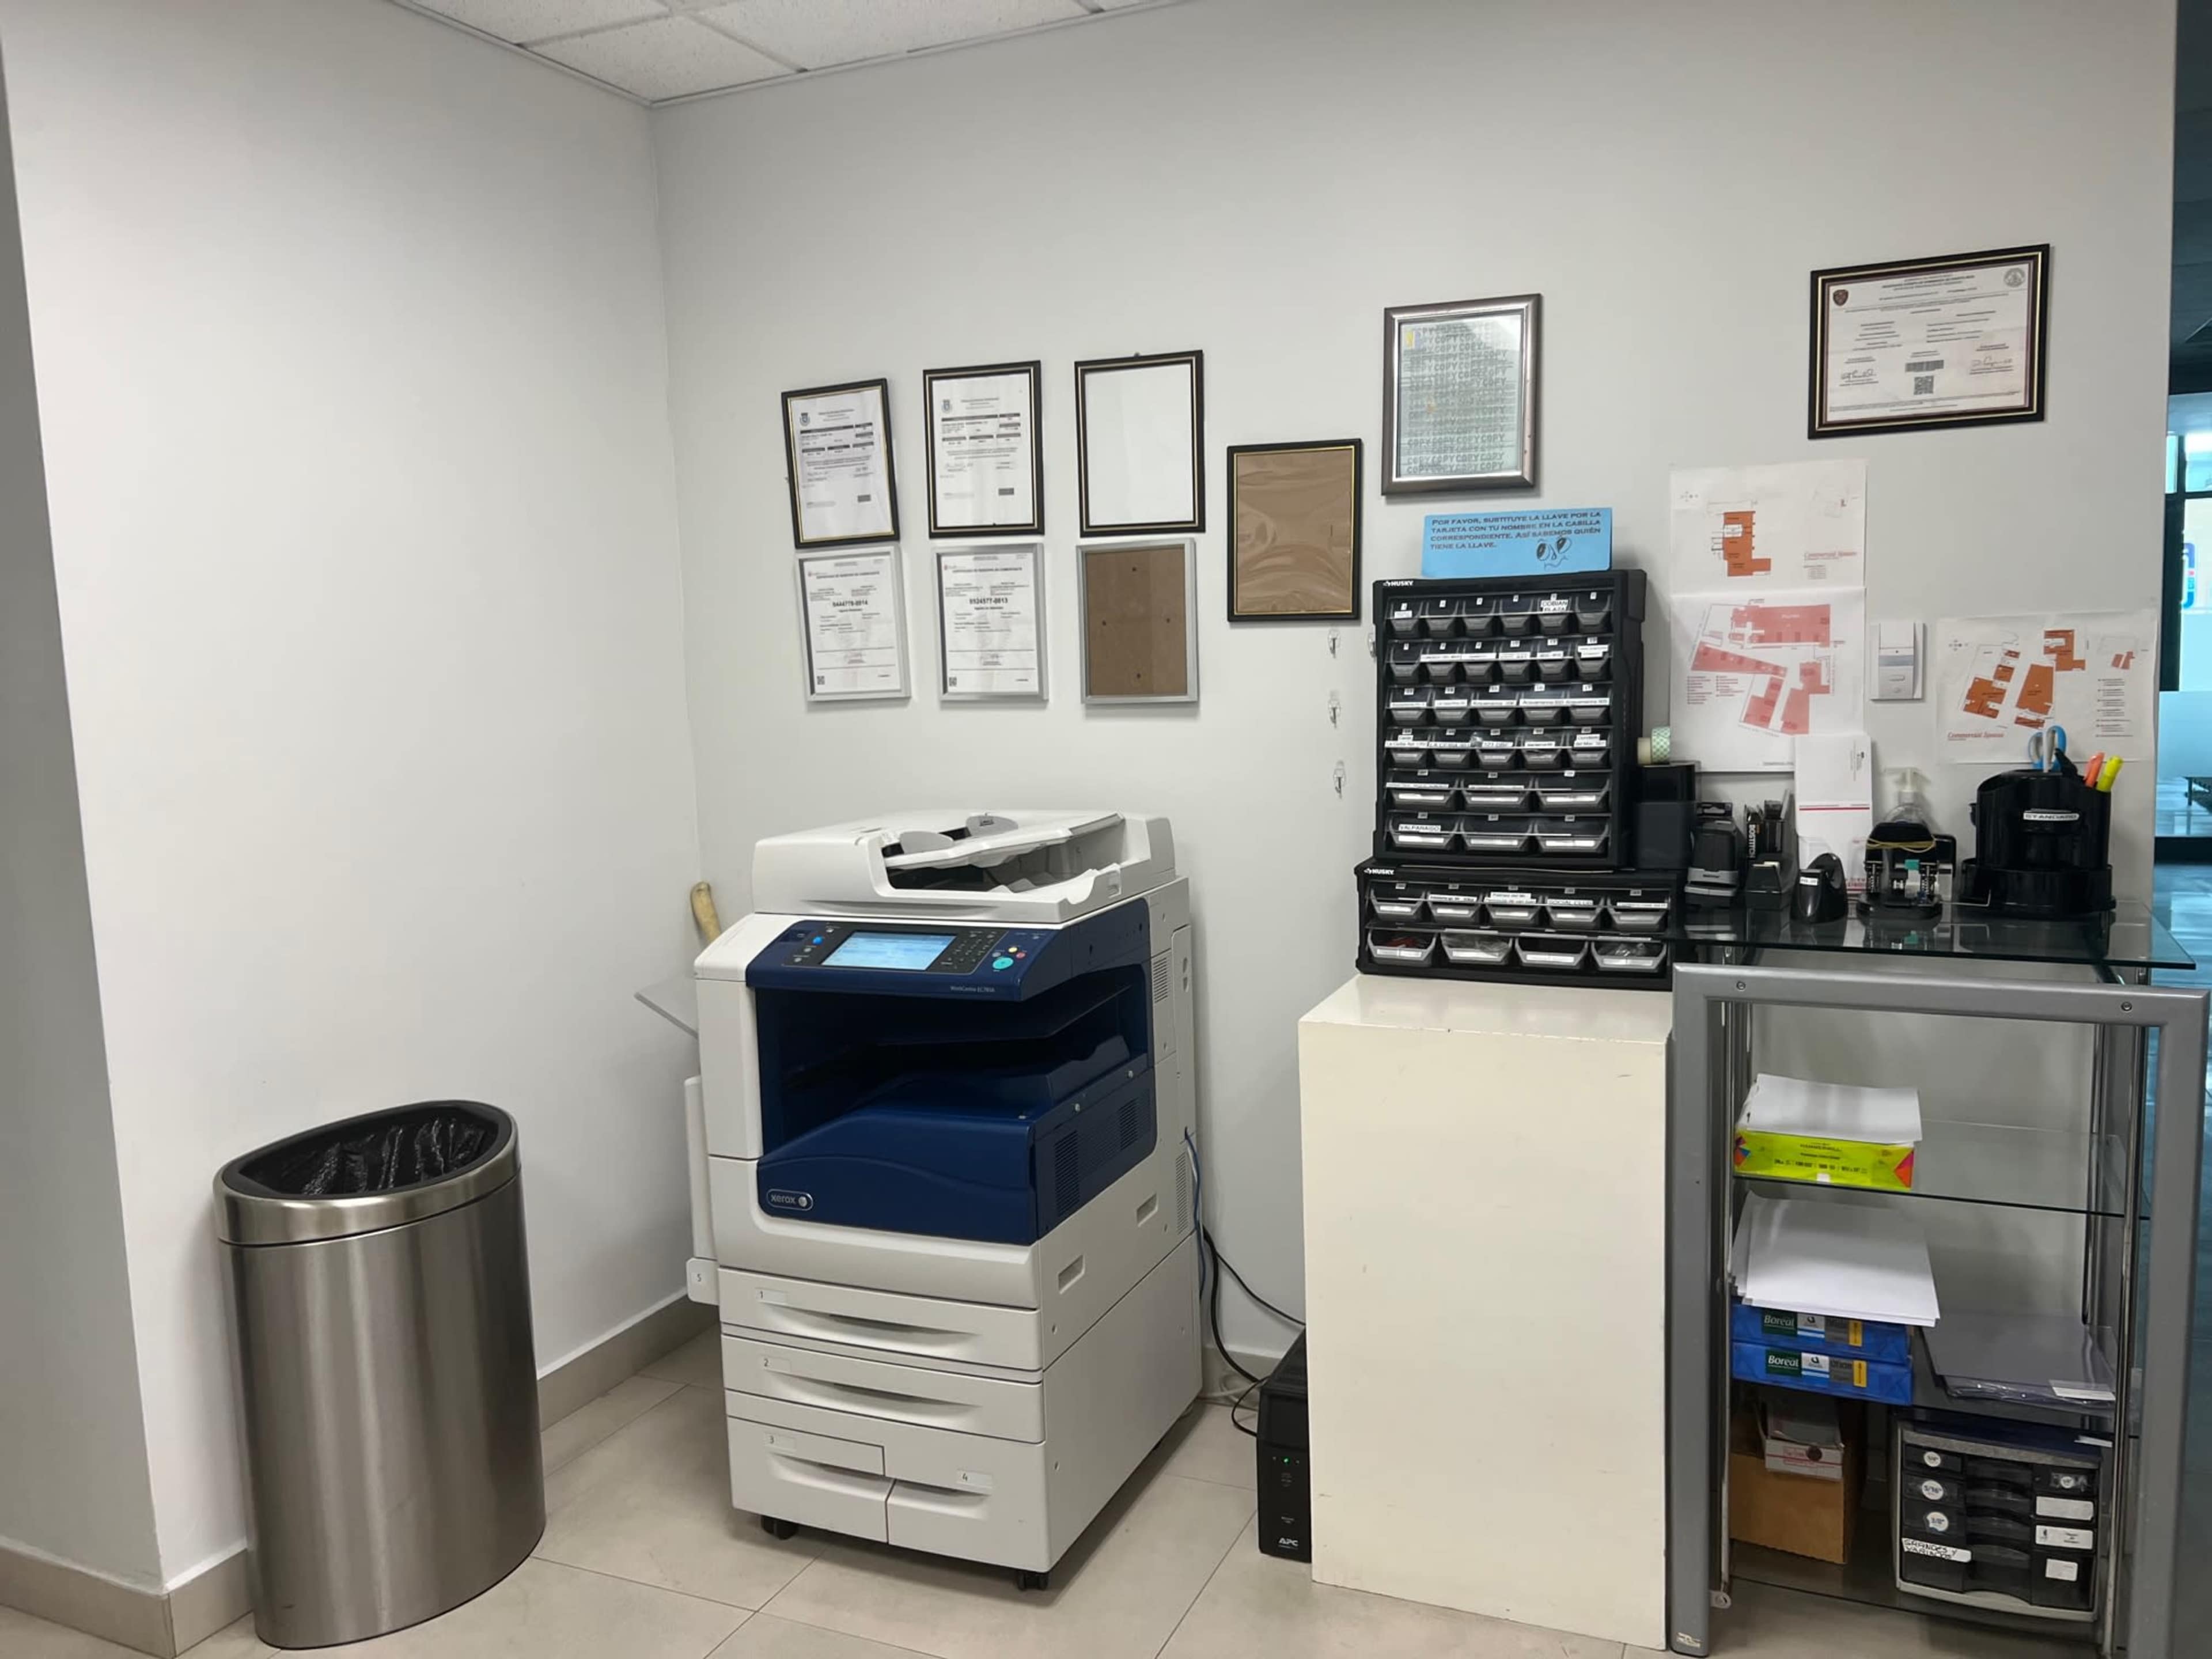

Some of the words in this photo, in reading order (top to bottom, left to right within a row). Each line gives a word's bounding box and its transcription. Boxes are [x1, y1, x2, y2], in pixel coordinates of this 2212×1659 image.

[771, 1194, 796, 1205] xerox
[697, 1274, 702, 1282] 5
[1764, 1315, 1795, 1326] Boreal
[764, 1358, 769, 1367] 2
[1768, 1355, 1799, 1368] Boreal
[770, 1435, 775, 1445] 3
[962, 1473, 968, 1482] 4
[1279, 1537, 1299, 1547] APC
